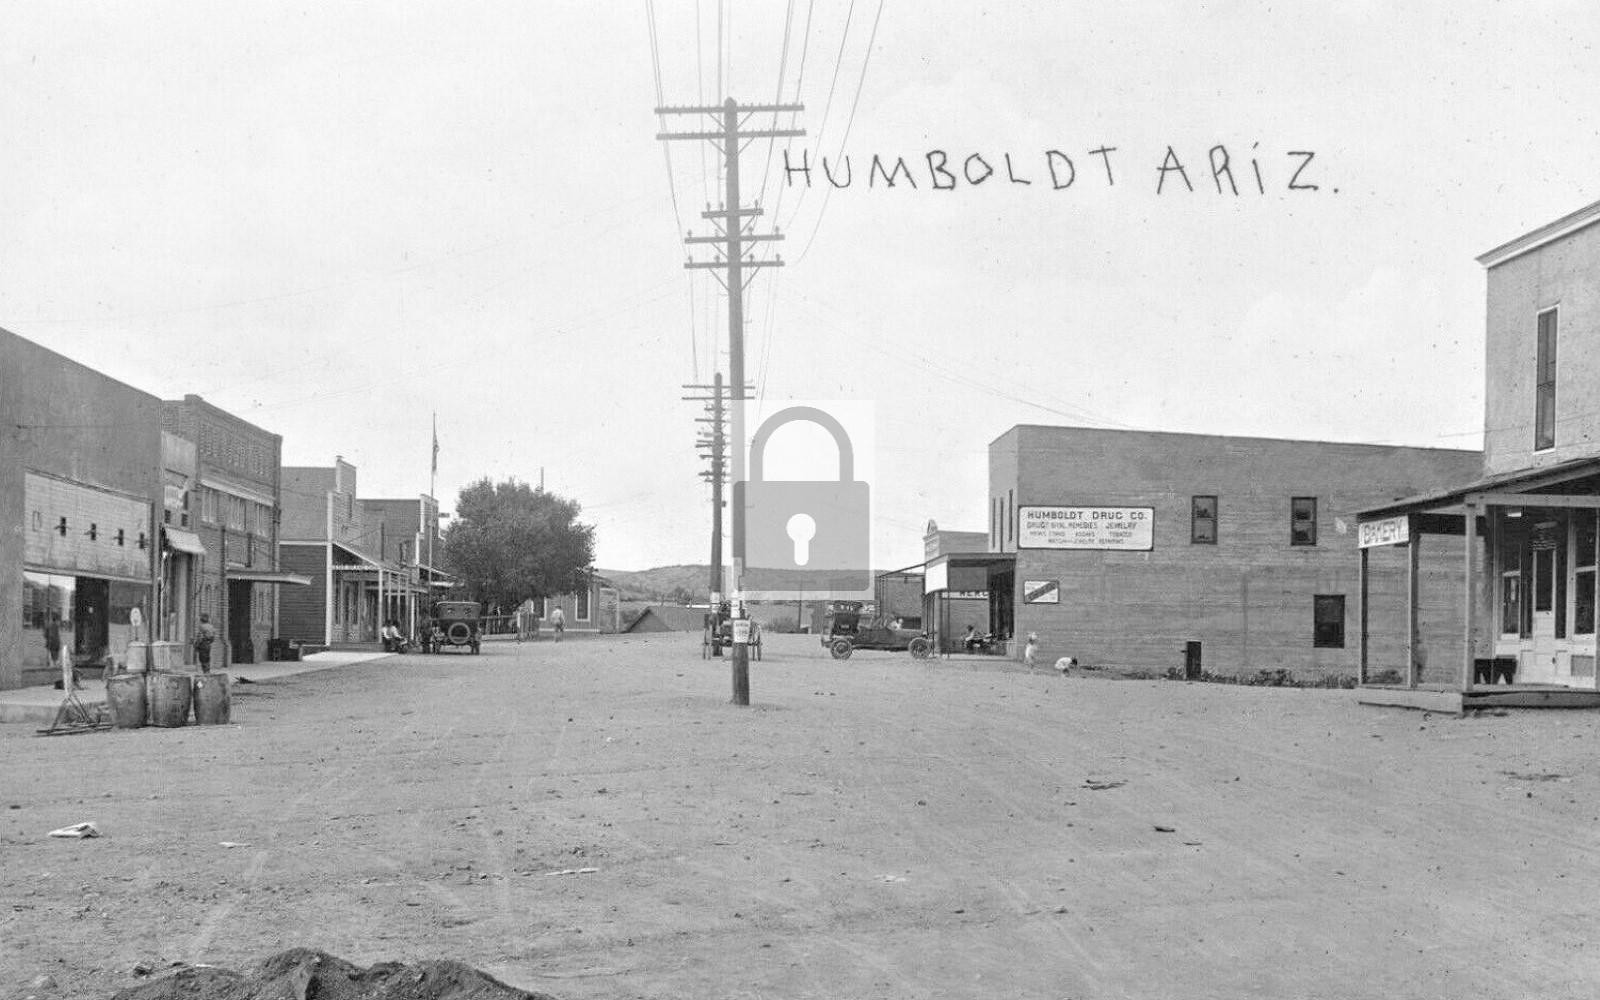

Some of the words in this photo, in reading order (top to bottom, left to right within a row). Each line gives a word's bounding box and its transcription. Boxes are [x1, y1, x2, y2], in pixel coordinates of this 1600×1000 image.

[1027, 510, 1084, 520] HUMBOLDT
[1092, 511, 1124, 520] DRUG
[1364, 518, 1403, 544] BAKERY
